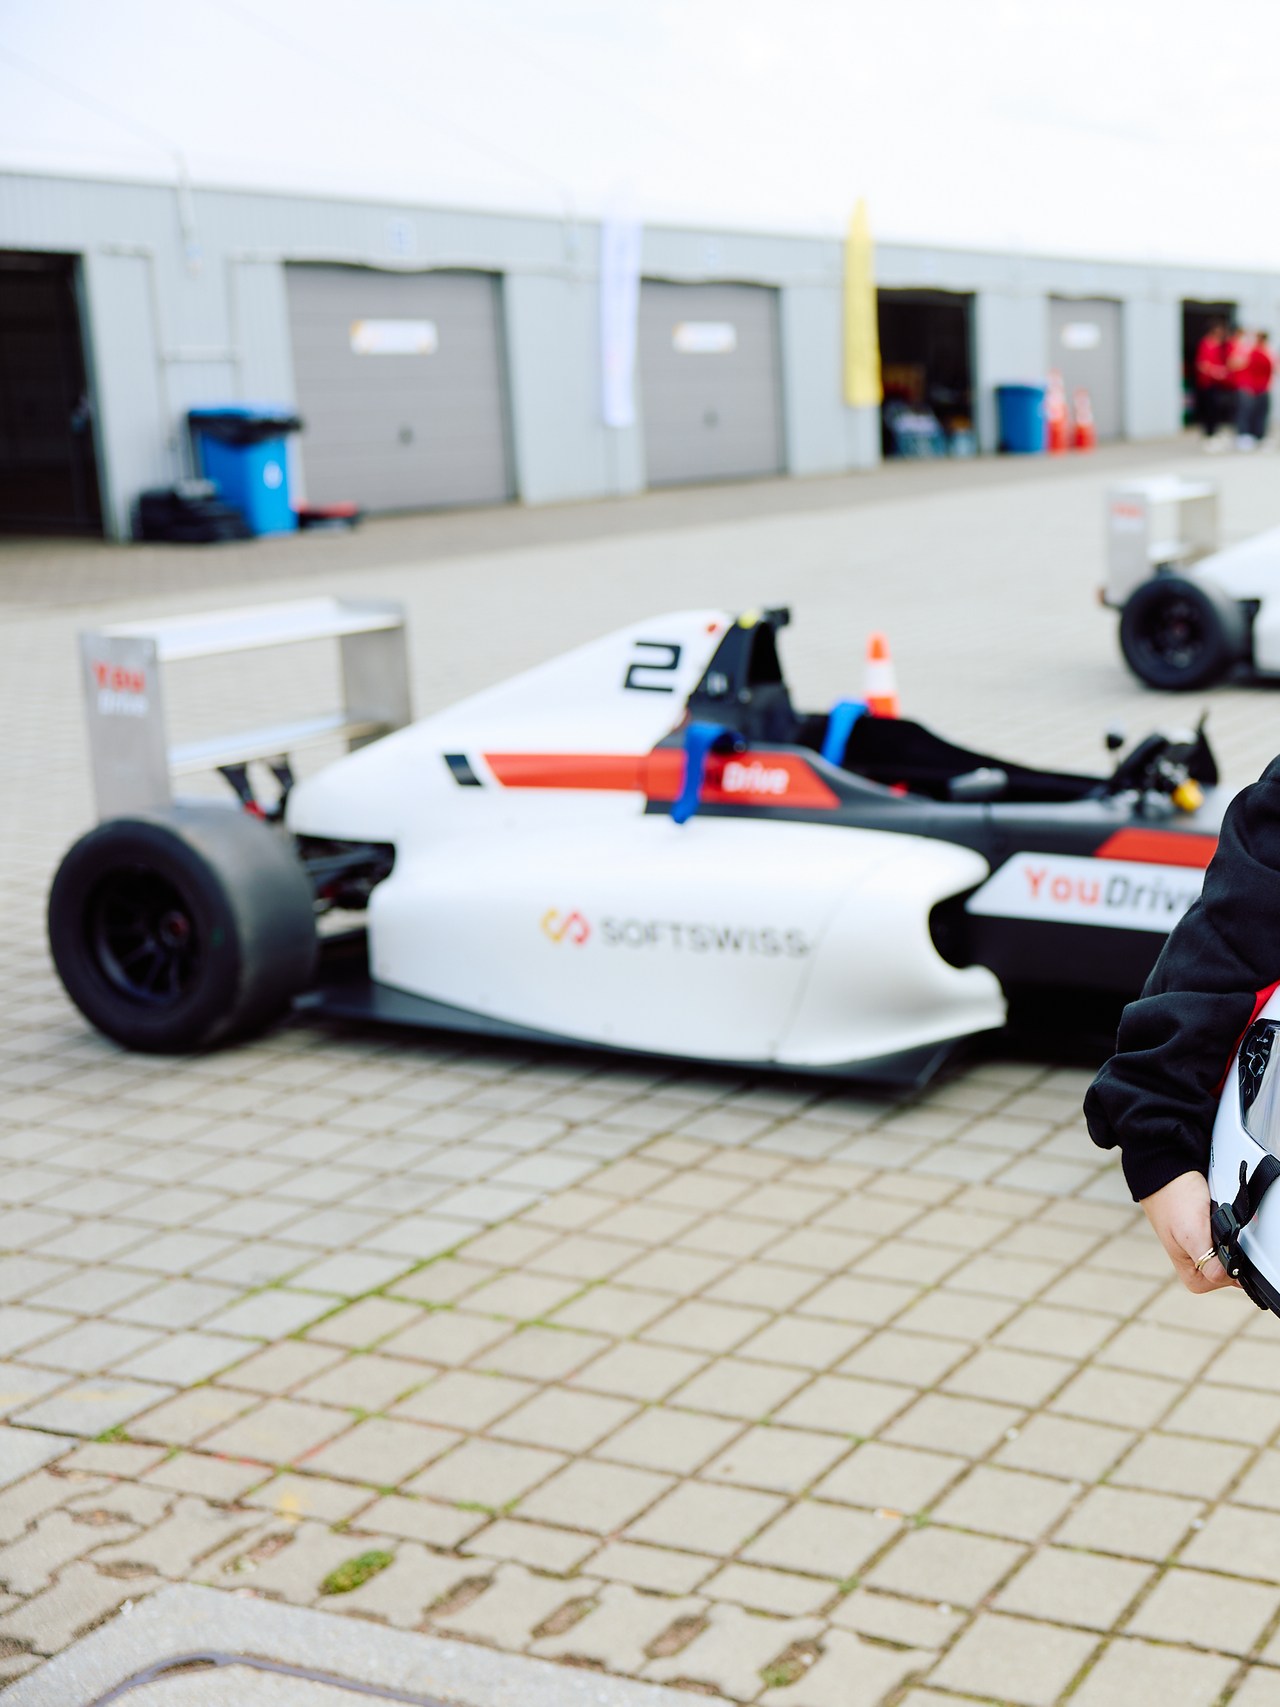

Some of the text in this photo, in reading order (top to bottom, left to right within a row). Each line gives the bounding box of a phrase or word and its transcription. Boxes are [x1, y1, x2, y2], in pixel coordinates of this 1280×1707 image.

[92, 659, 146, 694] You
[624, 642, 681, 692] 2
[601, 917, 809, 957] SOFTSWISS
